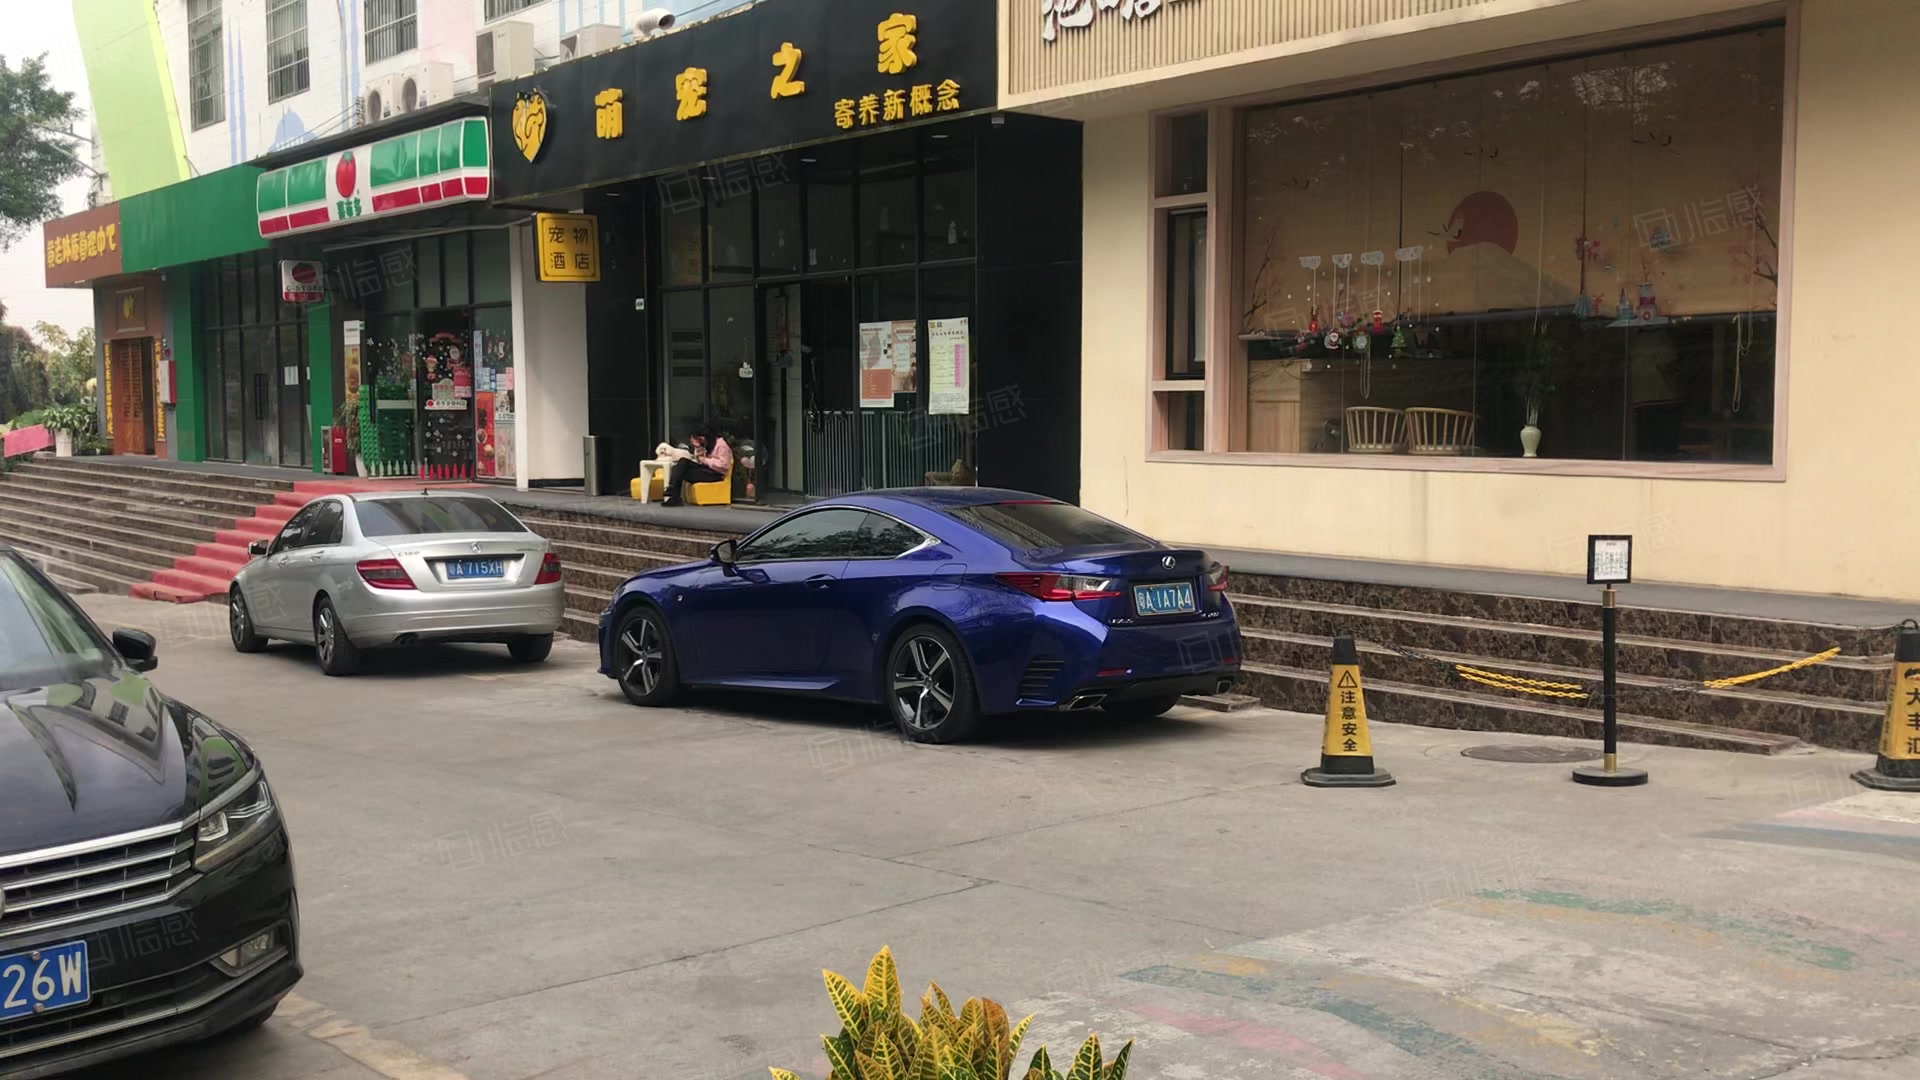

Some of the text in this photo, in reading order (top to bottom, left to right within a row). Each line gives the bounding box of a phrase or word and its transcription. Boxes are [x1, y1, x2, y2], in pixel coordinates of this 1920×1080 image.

[594, 12, 918, 140] 萌宠之家
[834, 79, 961, 129] 寄养新概念
[548, 225, 588, 245] 宠物
[550, 251, 590, 270] 酒店
[1340, 690, 1358, 752] 注意安全
[2, 951, 82, 1009] 26W
